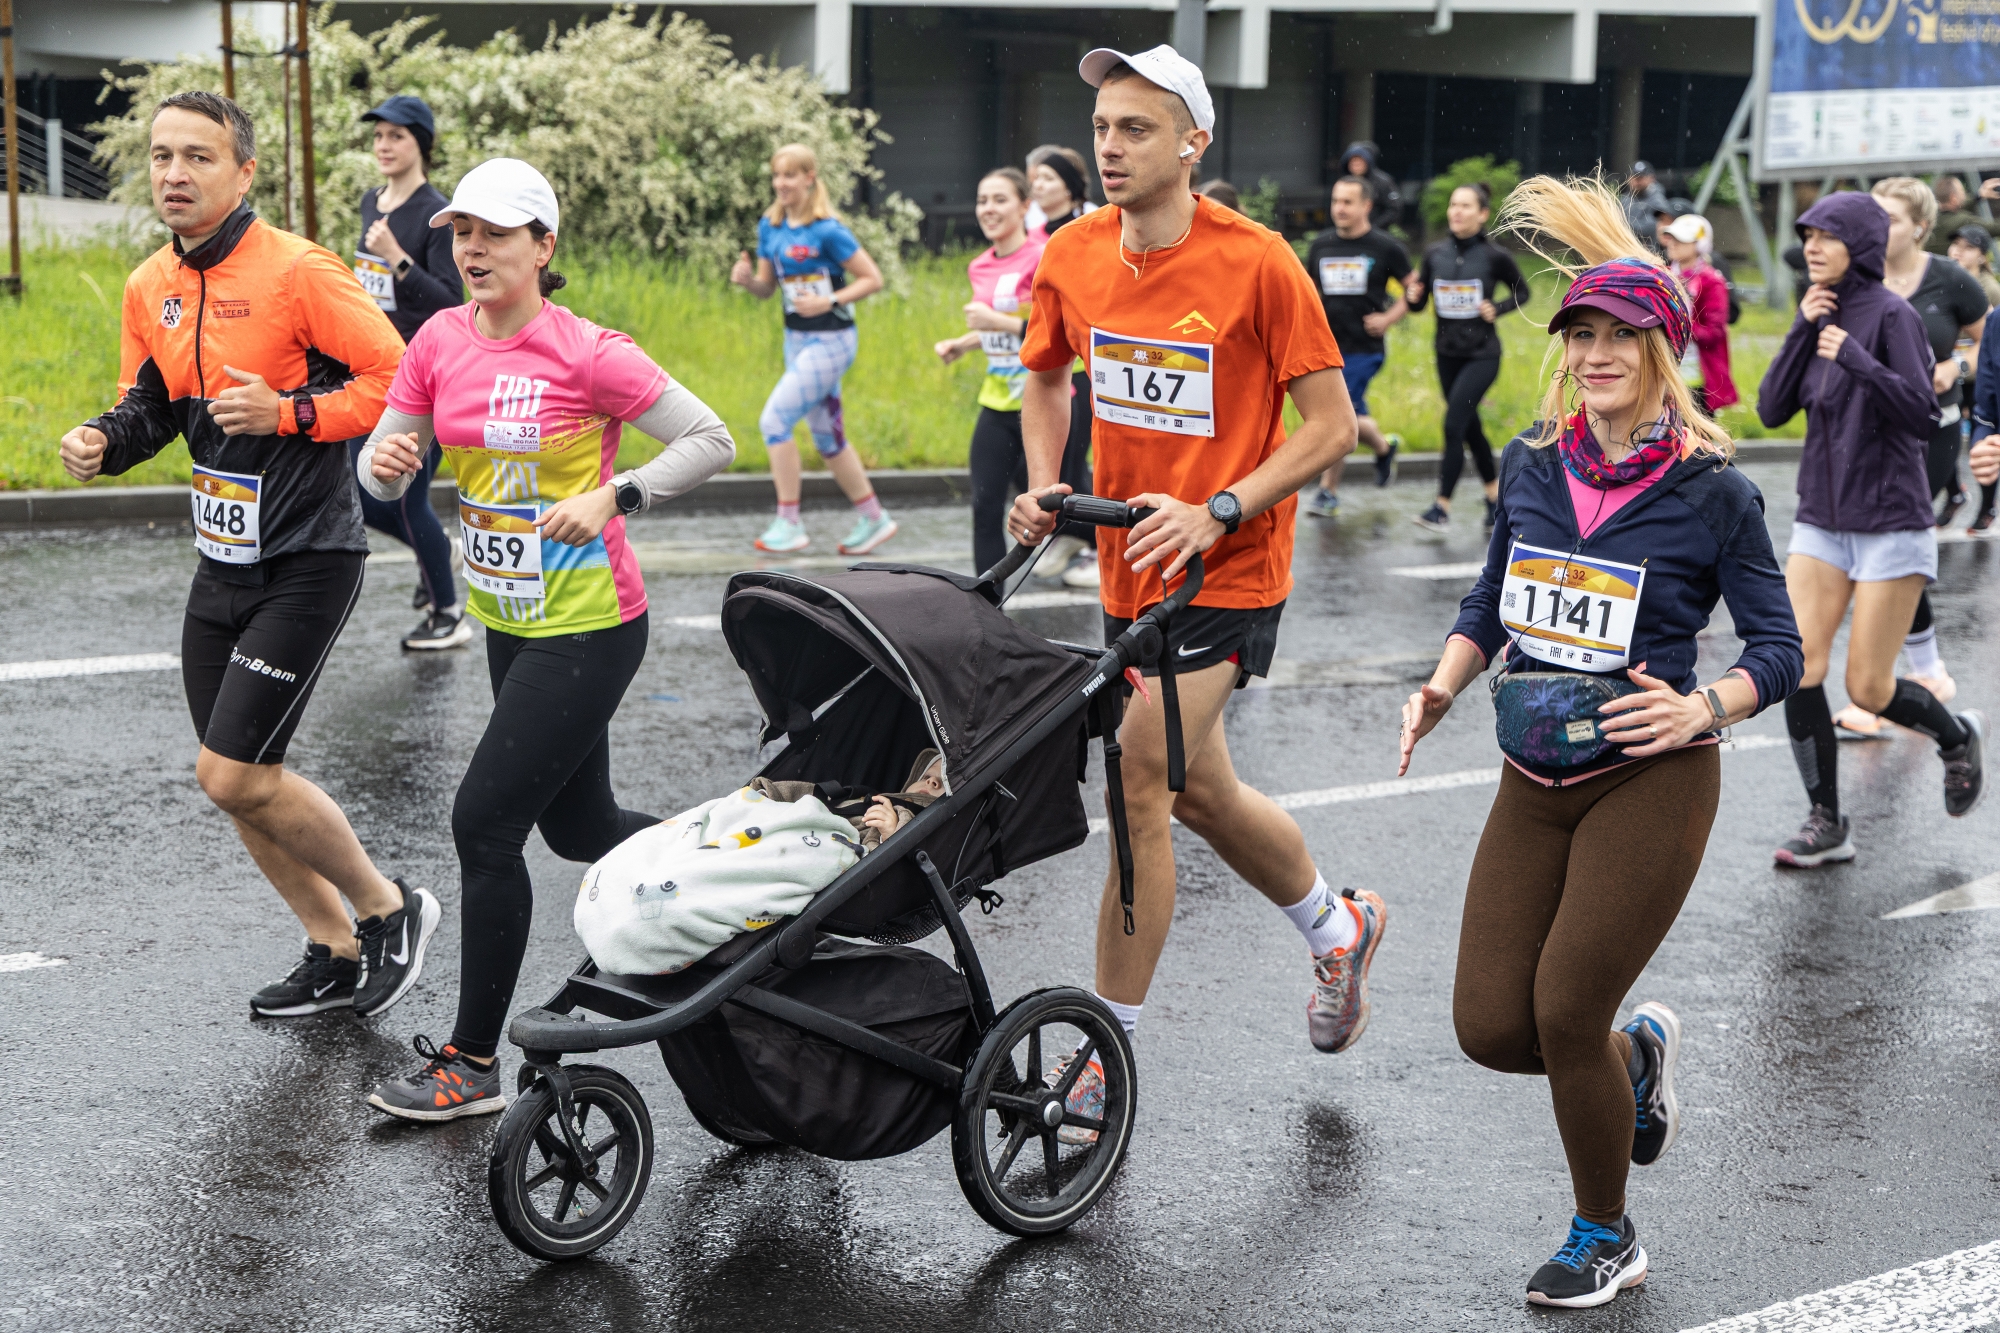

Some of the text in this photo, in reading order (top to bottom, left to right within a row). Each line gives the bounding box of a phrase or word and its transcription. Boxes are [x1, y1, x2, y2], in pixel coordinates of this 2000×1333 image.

[213, 308, 250, 316] MASTERS
[1151, 351, 1163, 360] 32
[1121, 366, 1186, 405] 167
[488, 374, 550, 418] FIAT
[1144, 414, 1155, 425] FIAT
[518, 426, 537, 438] 32
[211, 481, 220, 490] 32
[490, 457, 541, 499] FIAT
[195, 494, 246, 536] 1448
[481, 514, 492, 523] 32
[463, 526, 525, 569] 1659
[1572, 569, 1586, 581] 32
[1523, 584, 1612, 639] 1141
[1549, 645, 1563, 659] FIAT
[1081, 672, 1107, 697] THULE
[930, 704, 950, 745] Urban Glide
